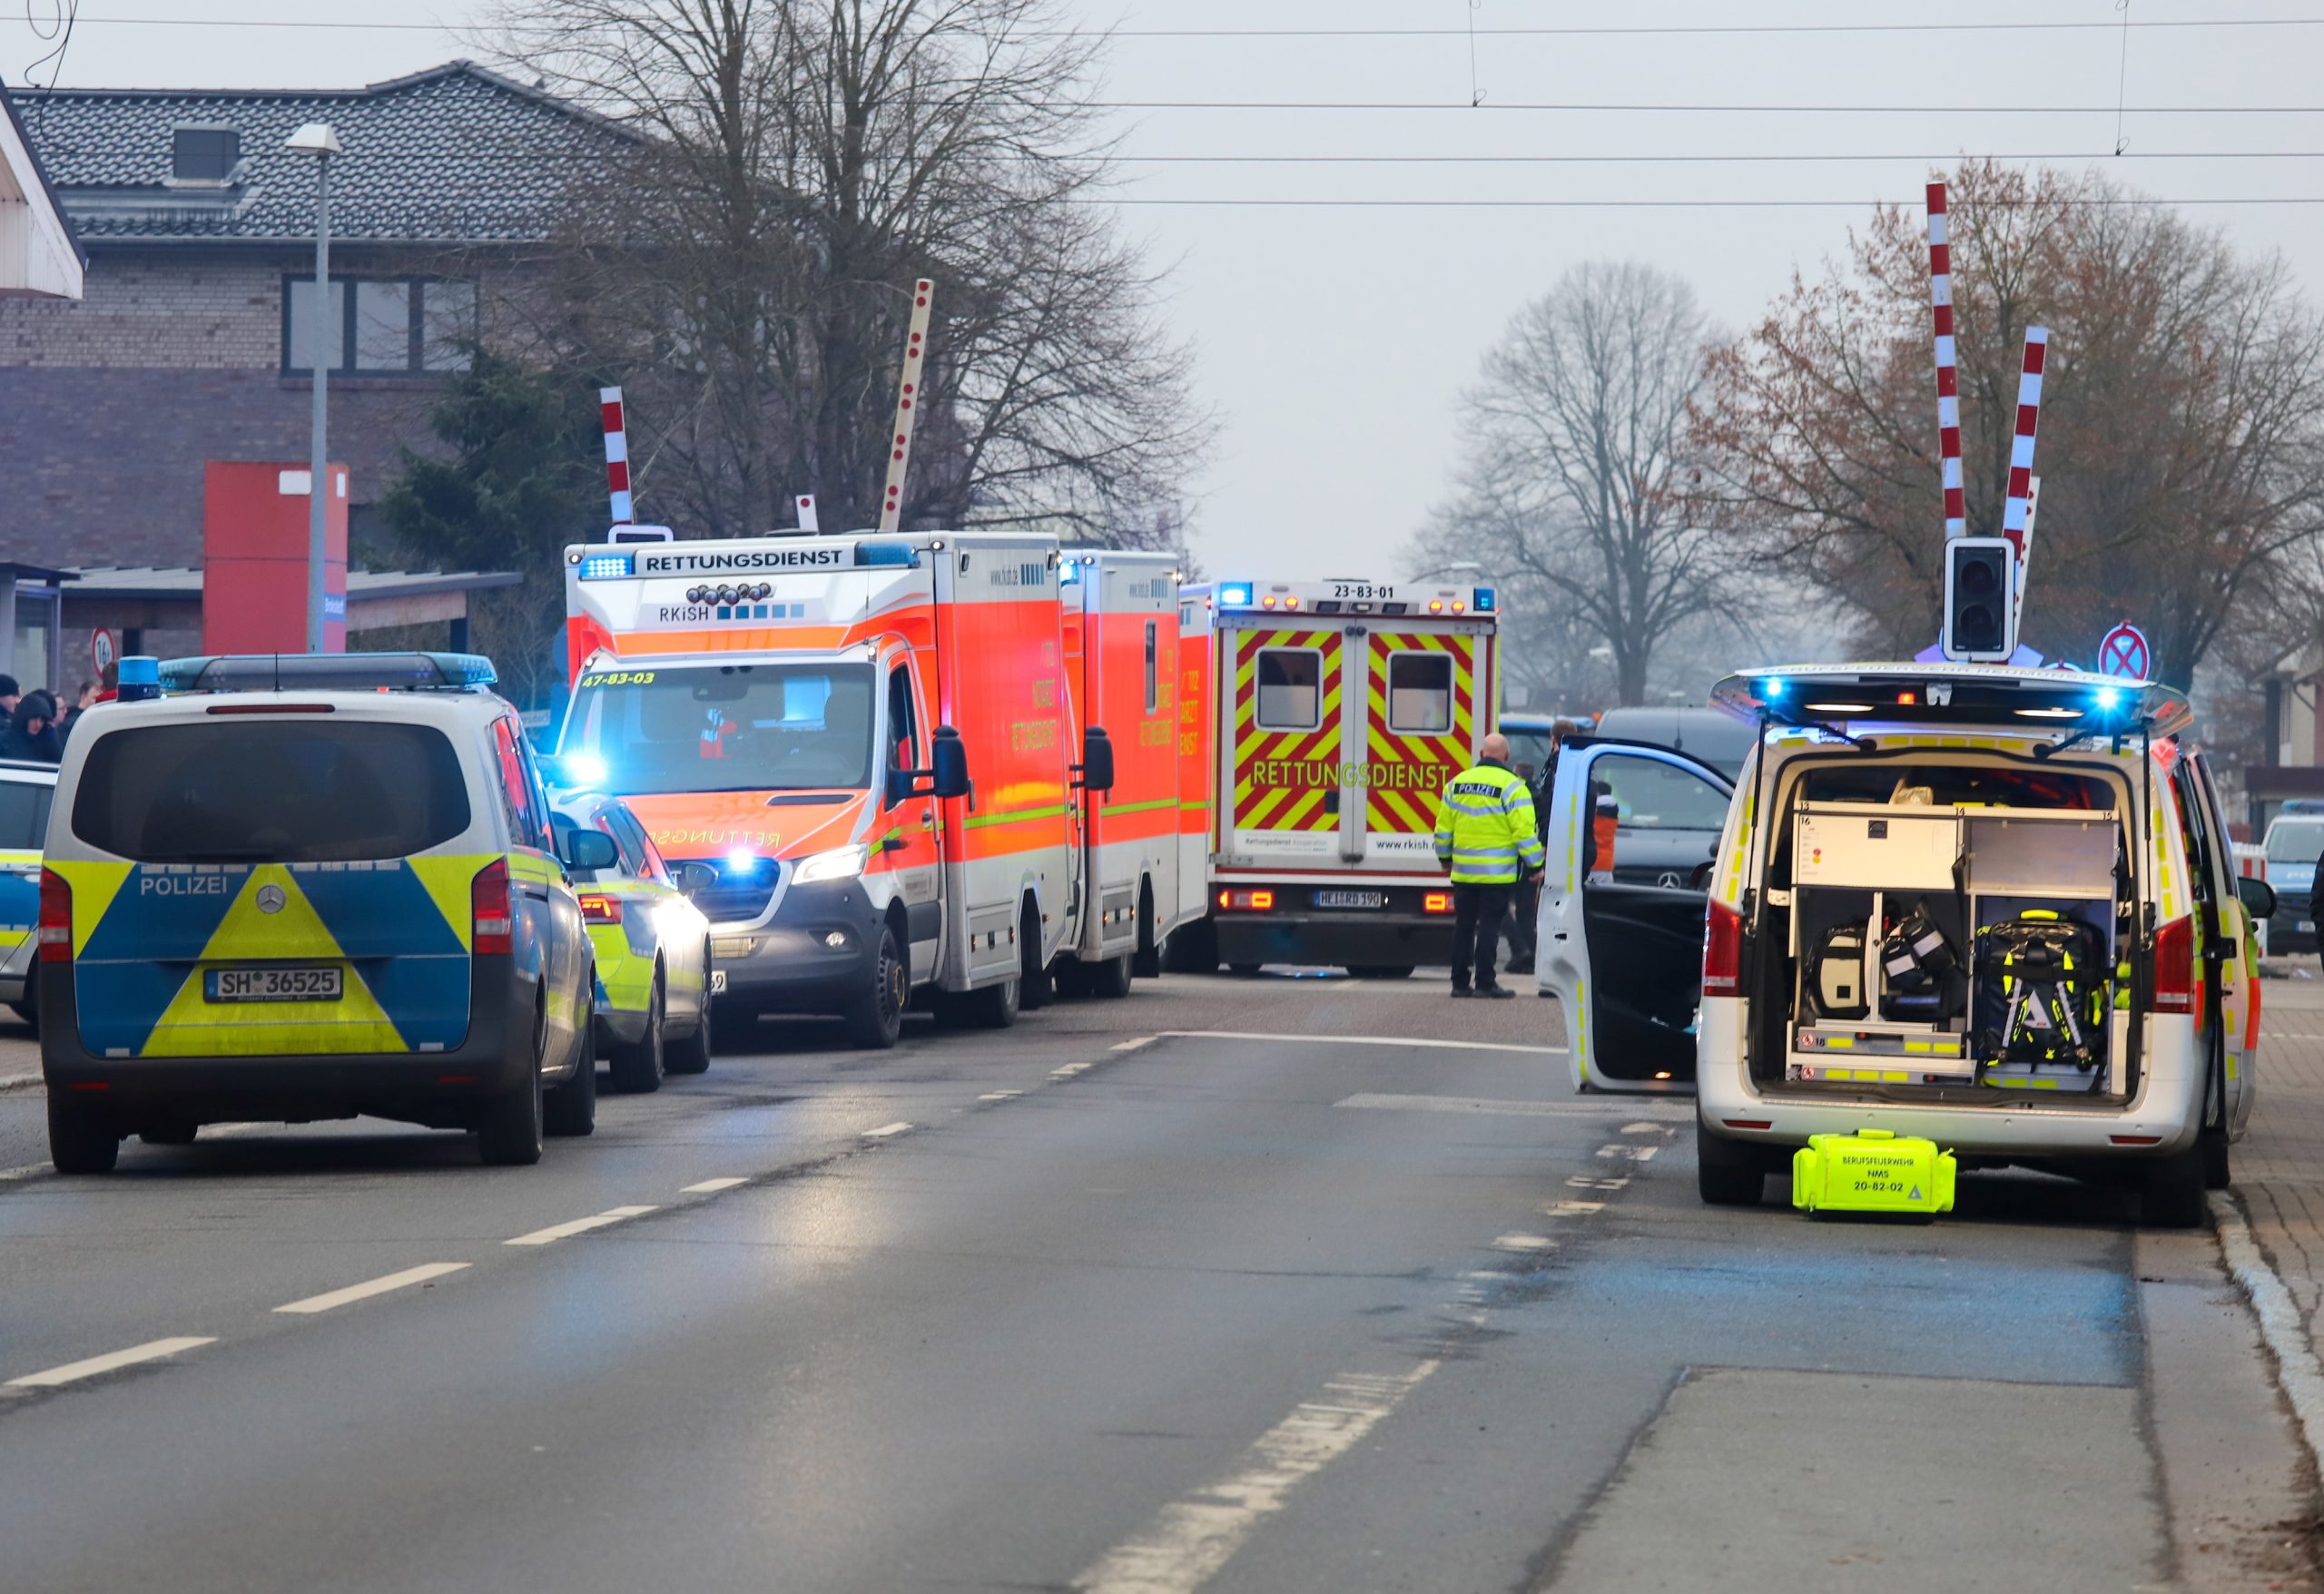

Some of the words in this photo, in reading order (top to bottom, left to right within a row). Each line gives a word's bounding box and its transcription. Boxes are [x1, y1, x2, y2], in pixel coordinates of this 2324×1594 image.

[646, 550, 842, 571] RETTUNGSDIENST
[1334, 585, 1393, 599] 23-83-01
[660, 606, 709, 622] RKiSH
[582, 673, 655, 688] 47-83-03
[1253, 761, 1451, 789] RETTUNGSDIENST
[1458, 783, 1496, 797] POLIZEI
[141, 875, 227, 896] POLIZEI
[1362, 892, 1380, 906] 190
[222, 972, 251, 994] SH
[266, 971, 335, 993] 36525
[1843, 1156, 1915, 1167] BERUFSFEUERWEHR
[1867, 1170, 1889, 1179] NMS
[1854, 1181, 1904, 1193] 20-82-02
